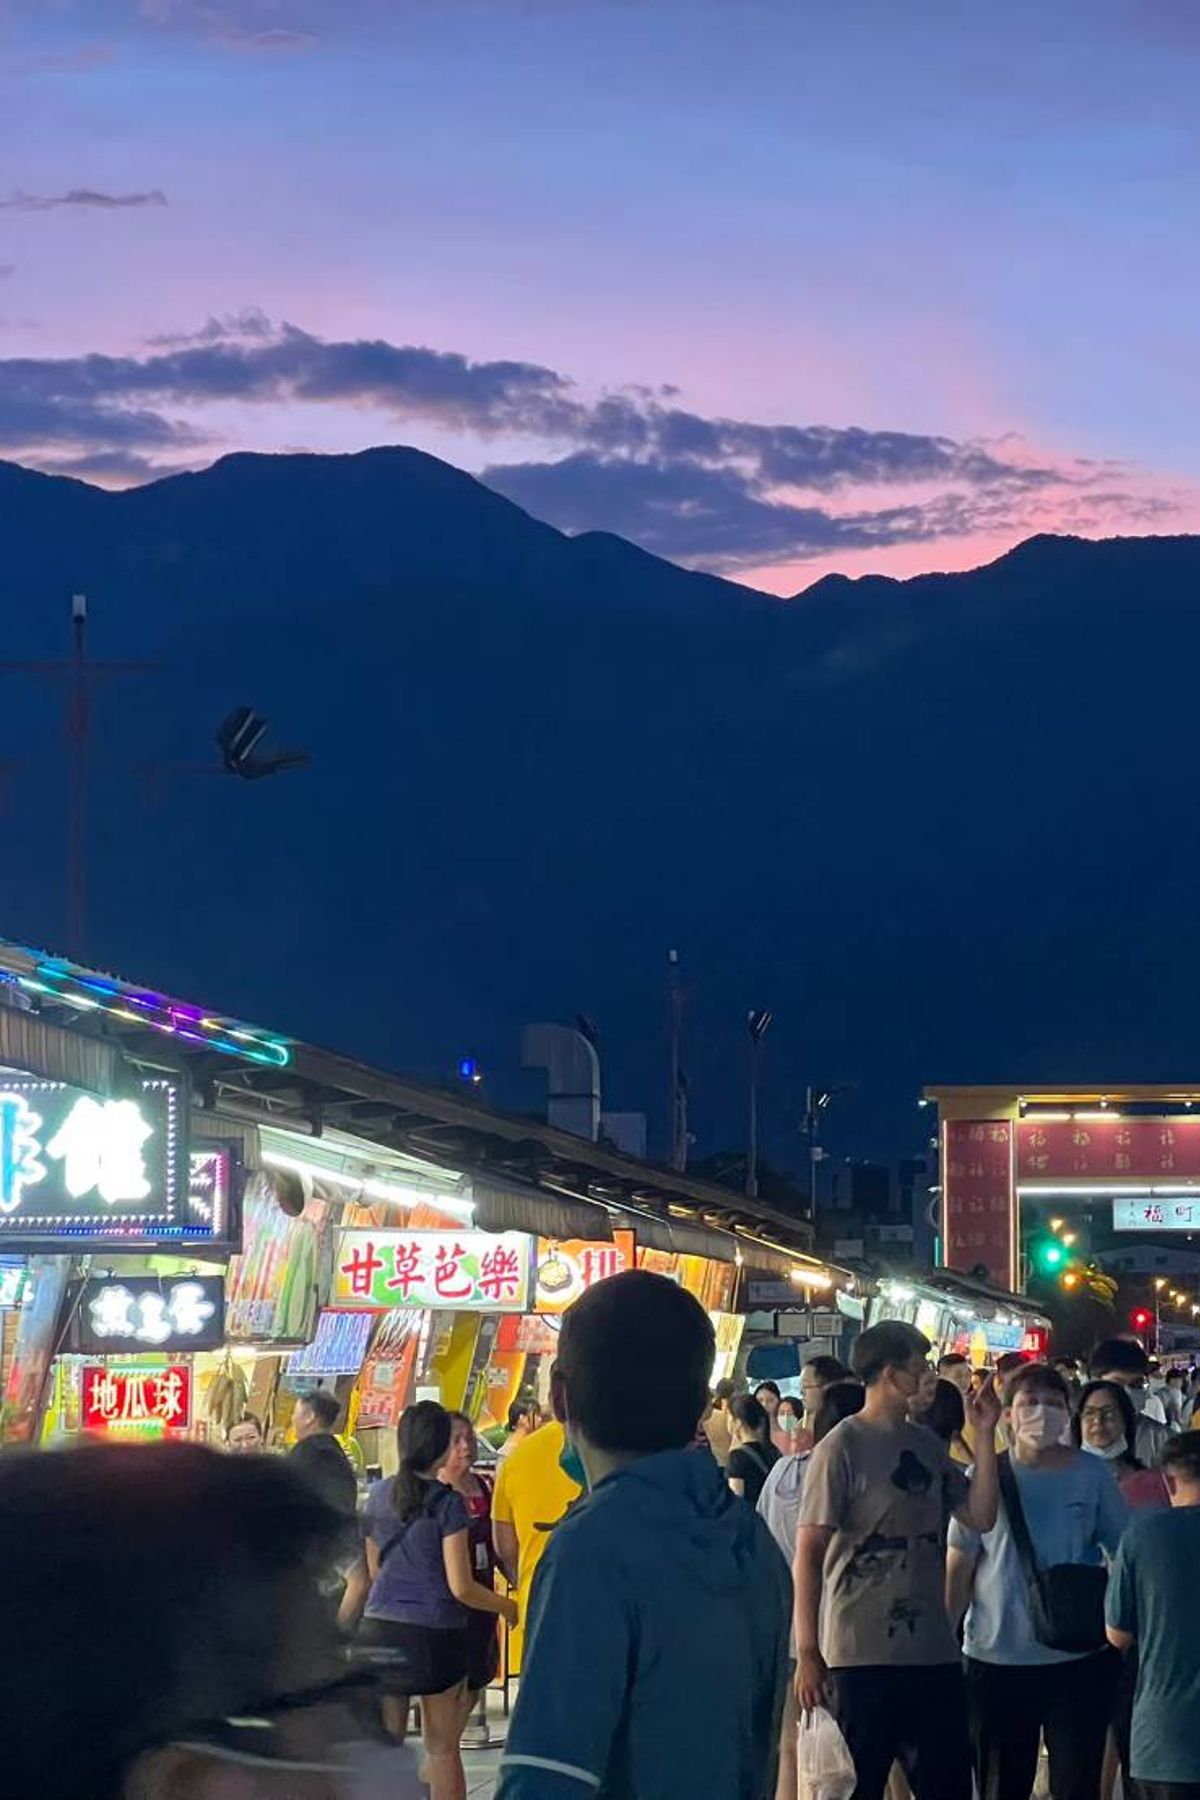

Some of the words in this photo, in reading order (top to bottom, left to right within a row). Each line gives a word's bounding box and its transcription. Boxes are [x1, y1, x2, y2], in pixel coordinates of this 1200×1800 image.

[341, 1241, 521, 1299] 甘草芭樂
[89, 1372, 182, 1420] 地瓜球
